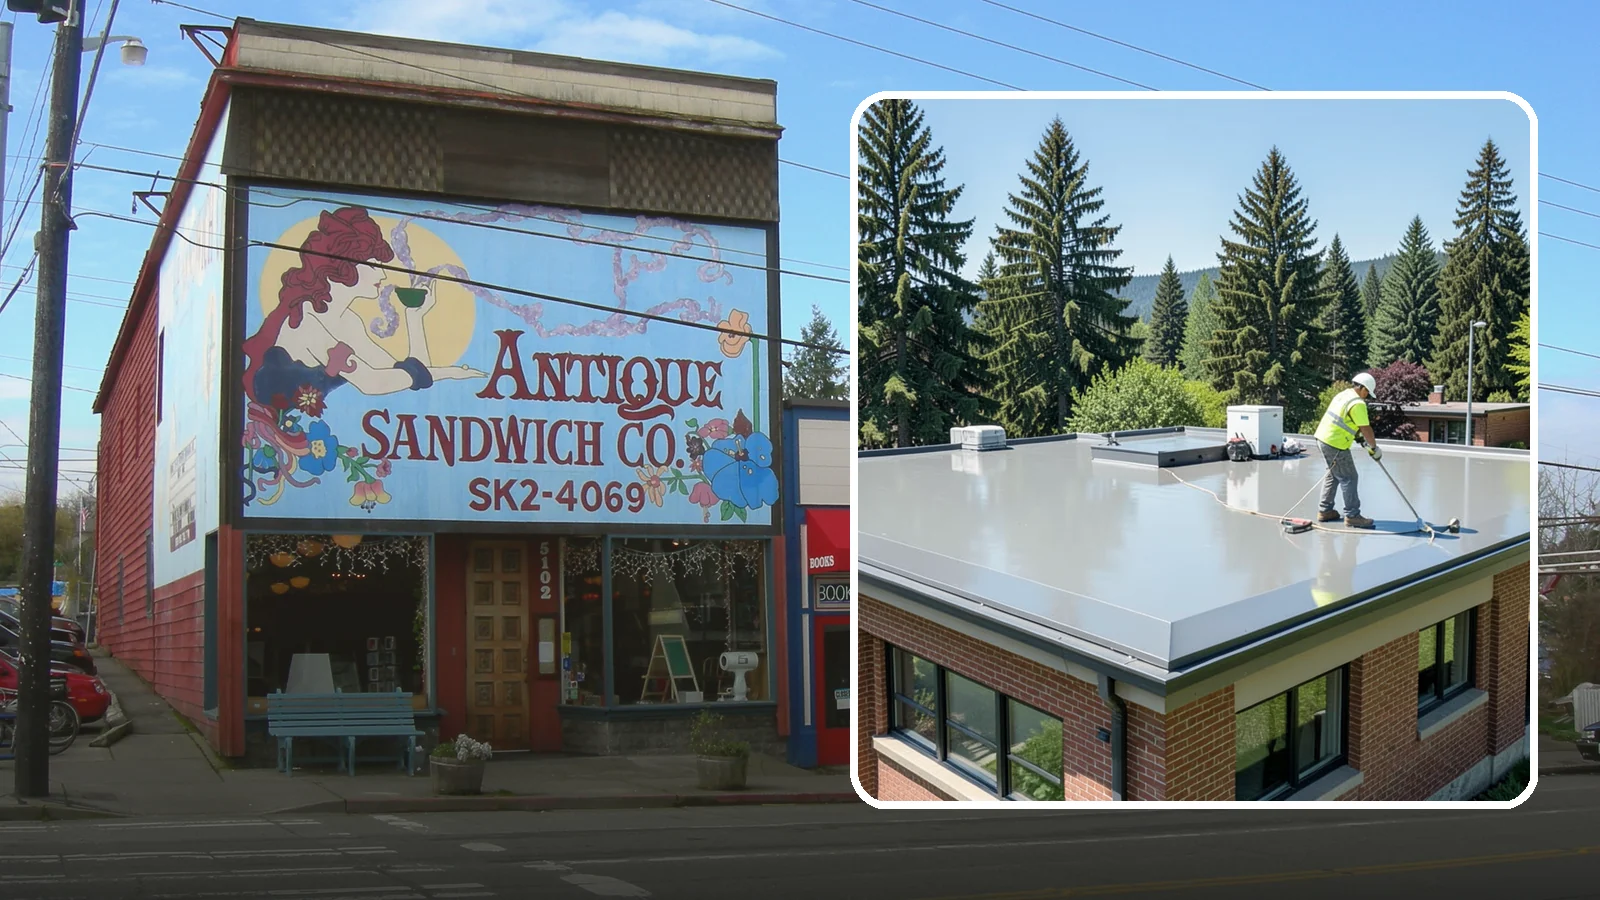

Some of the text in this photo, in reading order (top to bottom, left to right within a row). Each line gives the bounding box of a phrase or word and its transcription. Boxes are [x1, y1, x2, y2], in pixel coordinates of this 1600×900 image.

[476, 329, 724, 421] ANTIQUE
[361, 408, 685, 468] SANDWICH CO.
[468, 477, 645, 513] SK2-4069
[539, 541, 551, 600] 5102
[809, 555, 835, 569] BOOKS
